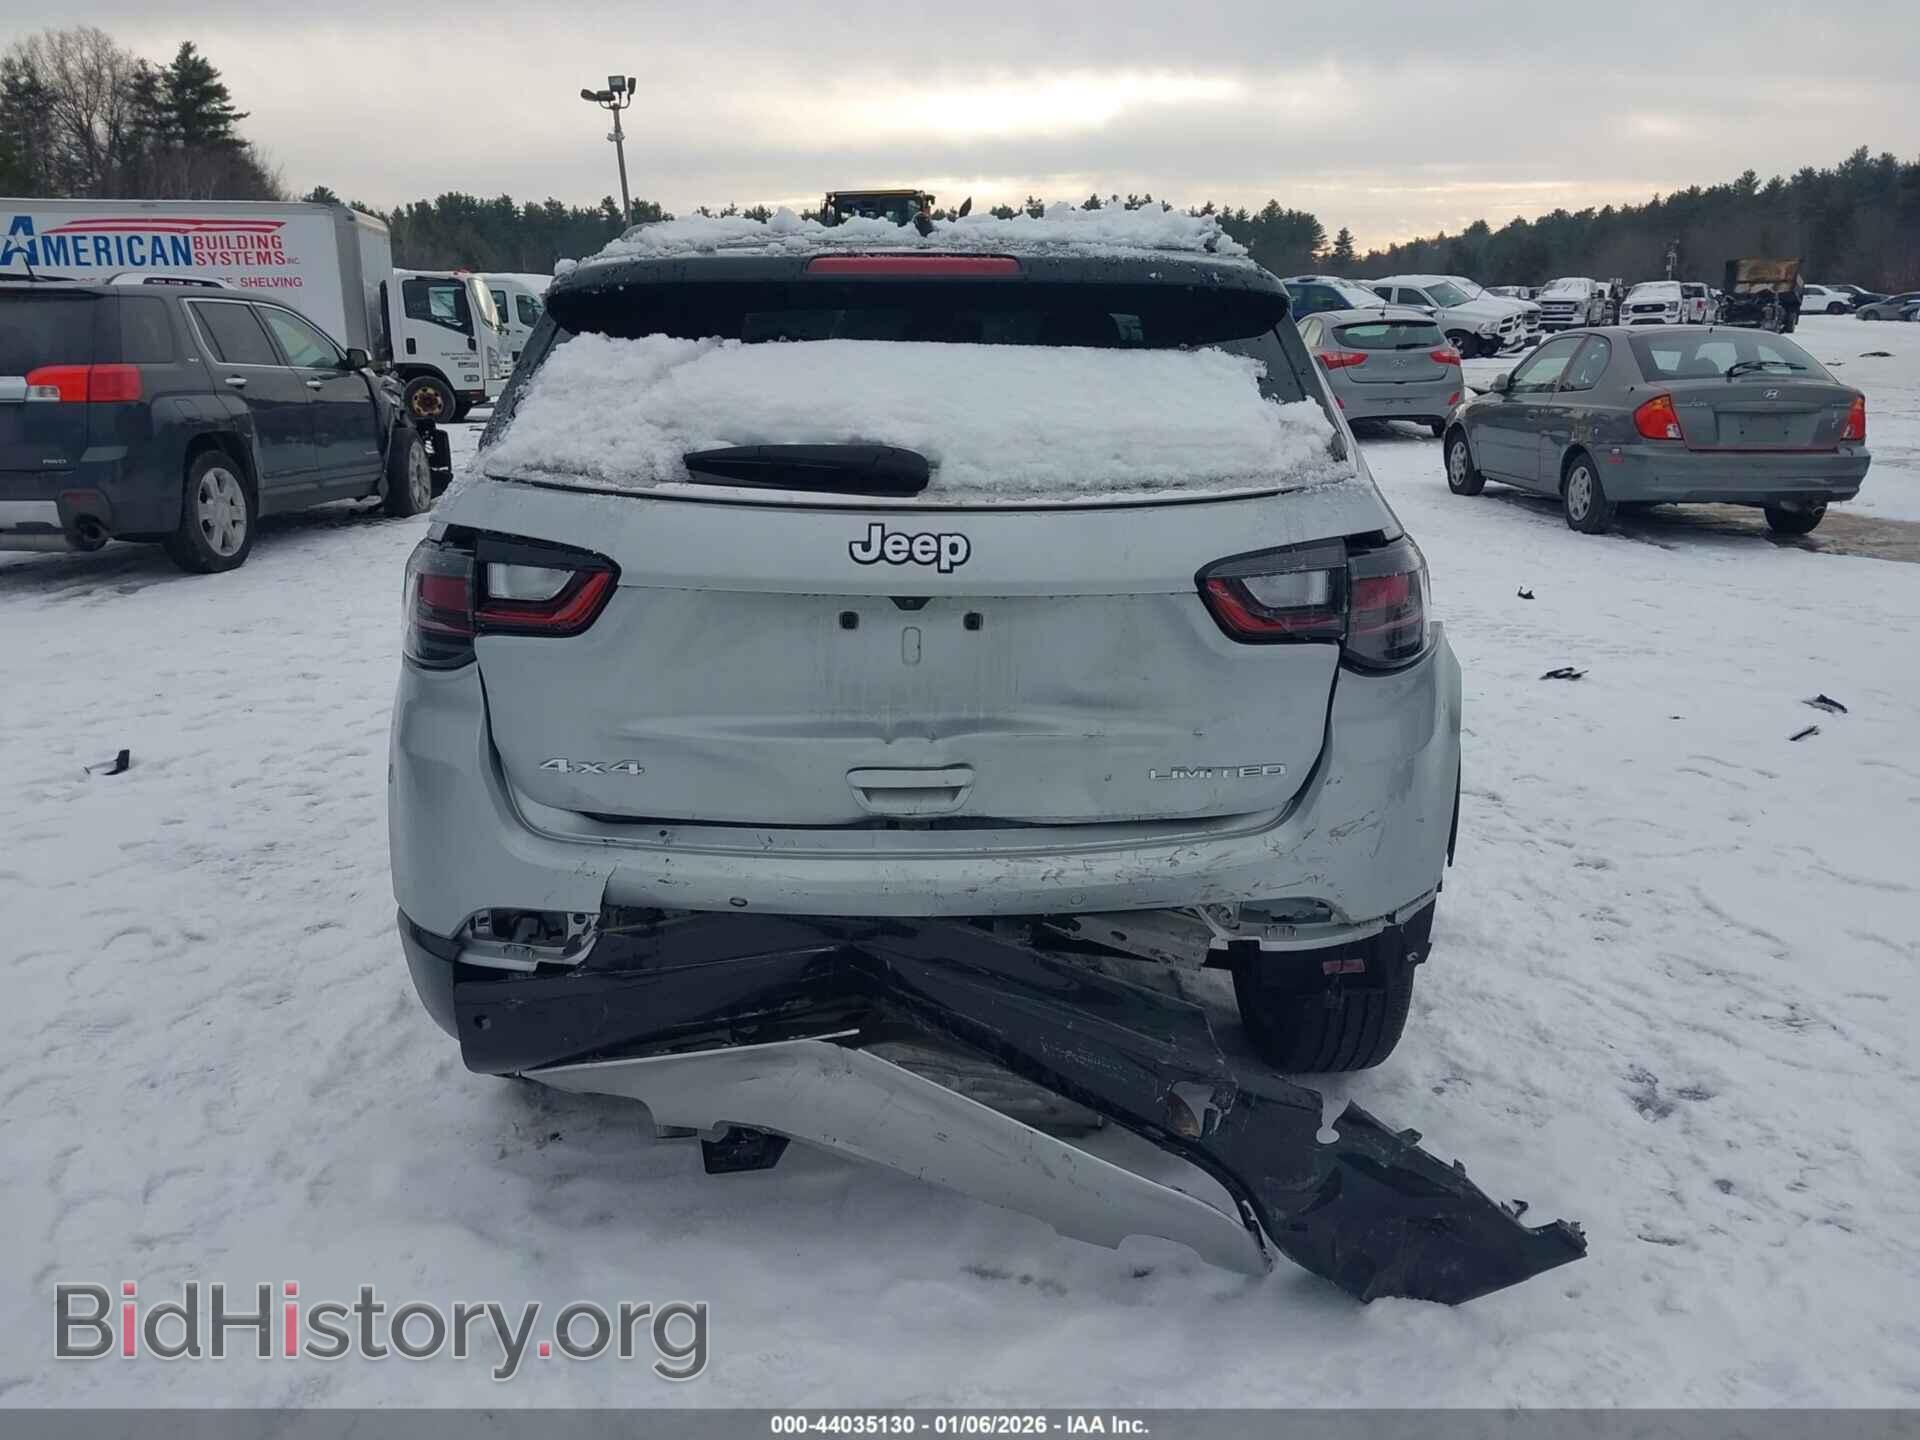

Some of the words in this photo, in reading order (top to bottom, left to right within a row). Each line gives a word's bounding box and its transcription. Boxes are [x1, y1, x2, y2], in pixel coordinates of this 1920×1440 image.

[0, 216, 192, 266] AMERICAN
[193, 235, 282, 249] BUILDING
[194, 251, 286, 265] SYSTEMS
[240, 277, 303, 287] SHELVING
[849, 523, 971, 573] Jeep
[1149, 763, 1287, 780] LIMITED
